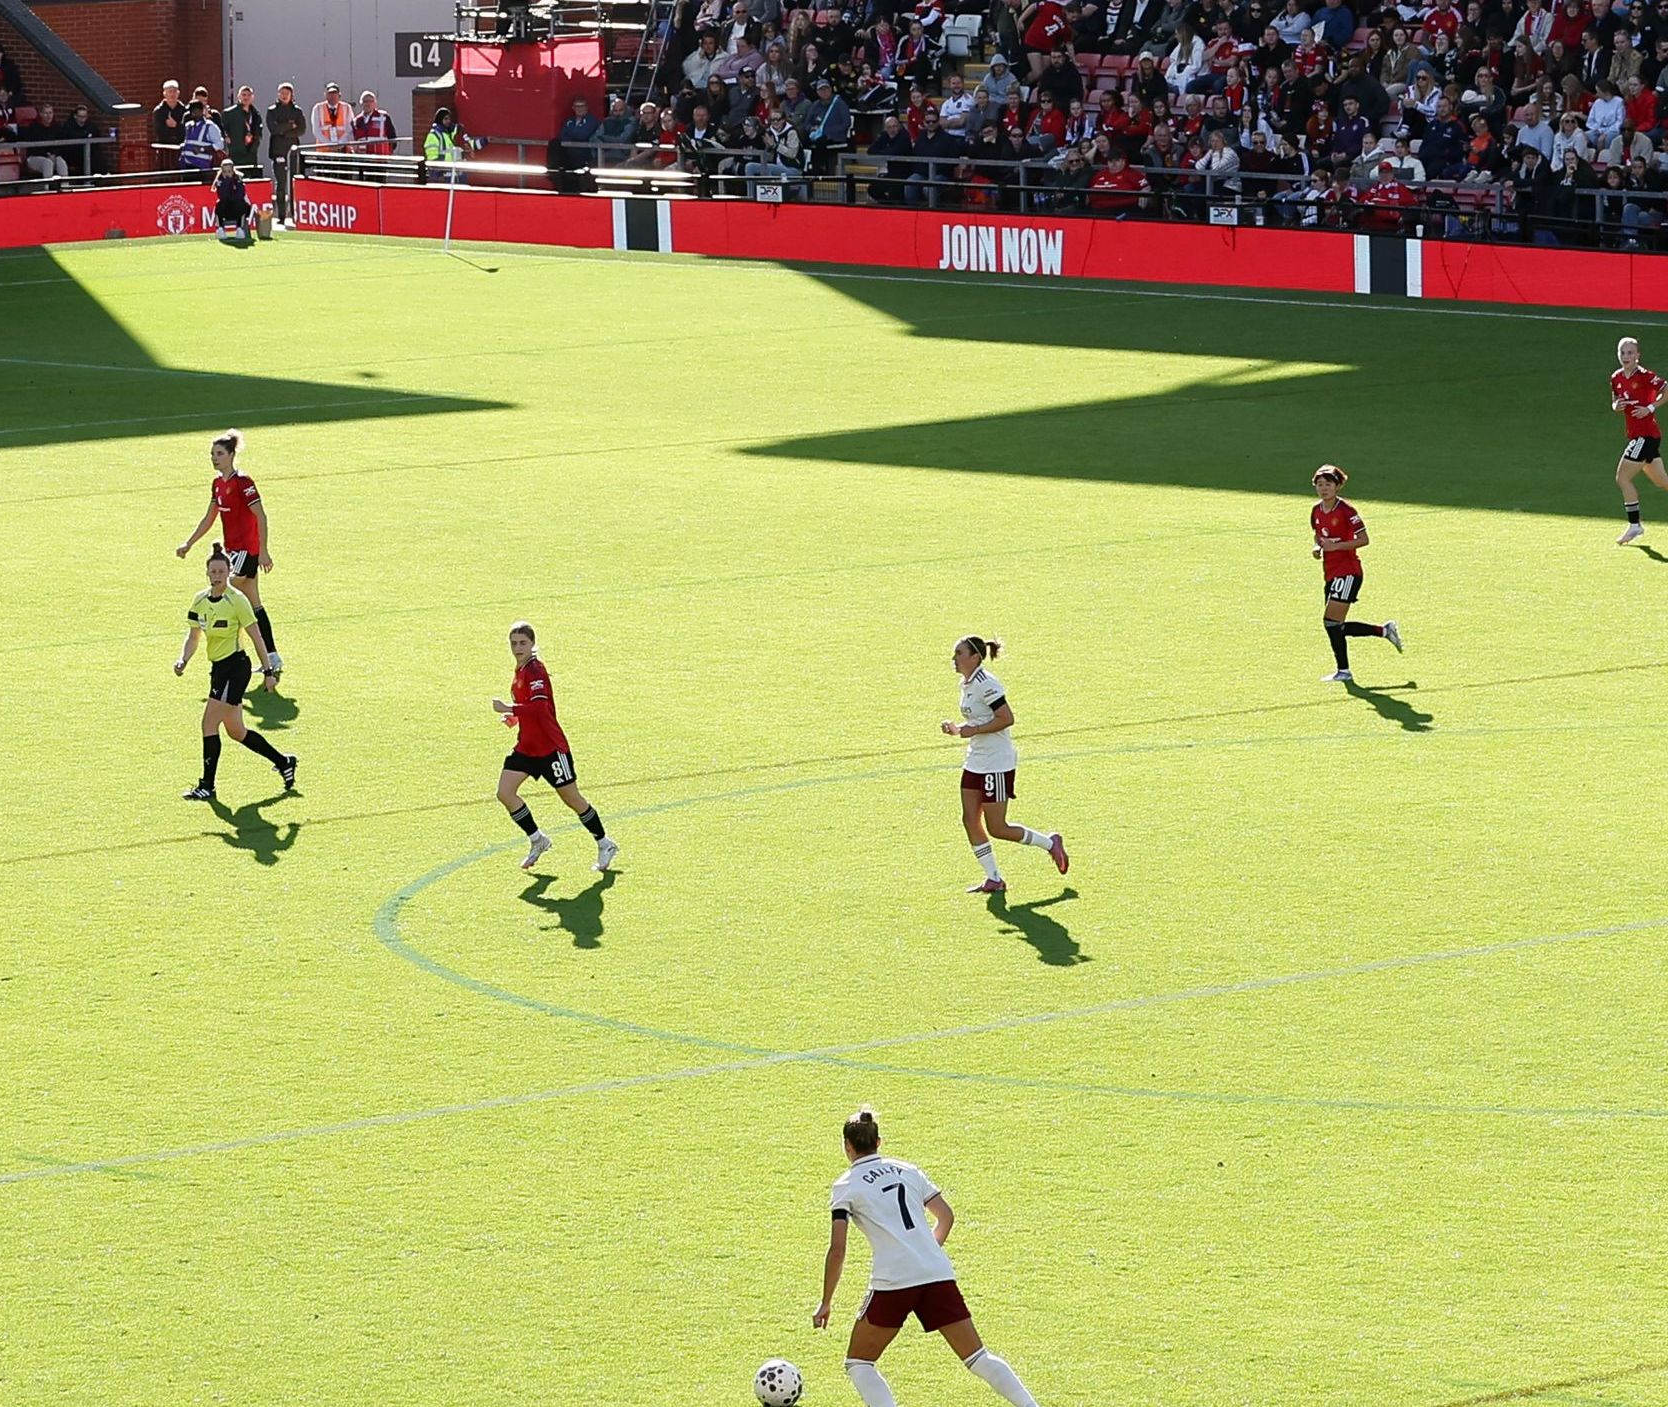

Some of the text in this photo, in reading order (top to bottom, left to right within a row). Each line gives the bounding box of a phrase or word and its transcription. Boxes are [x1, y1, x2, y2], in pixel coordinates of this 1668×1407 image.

[408, 42, 441, 69] Q4
[939, 225, 1063, 276] JOIN NOW
[551, 761, 563, 778] 8
[984, 774, 995, 791] 8
[881, 1182, 915, 1230] 7
